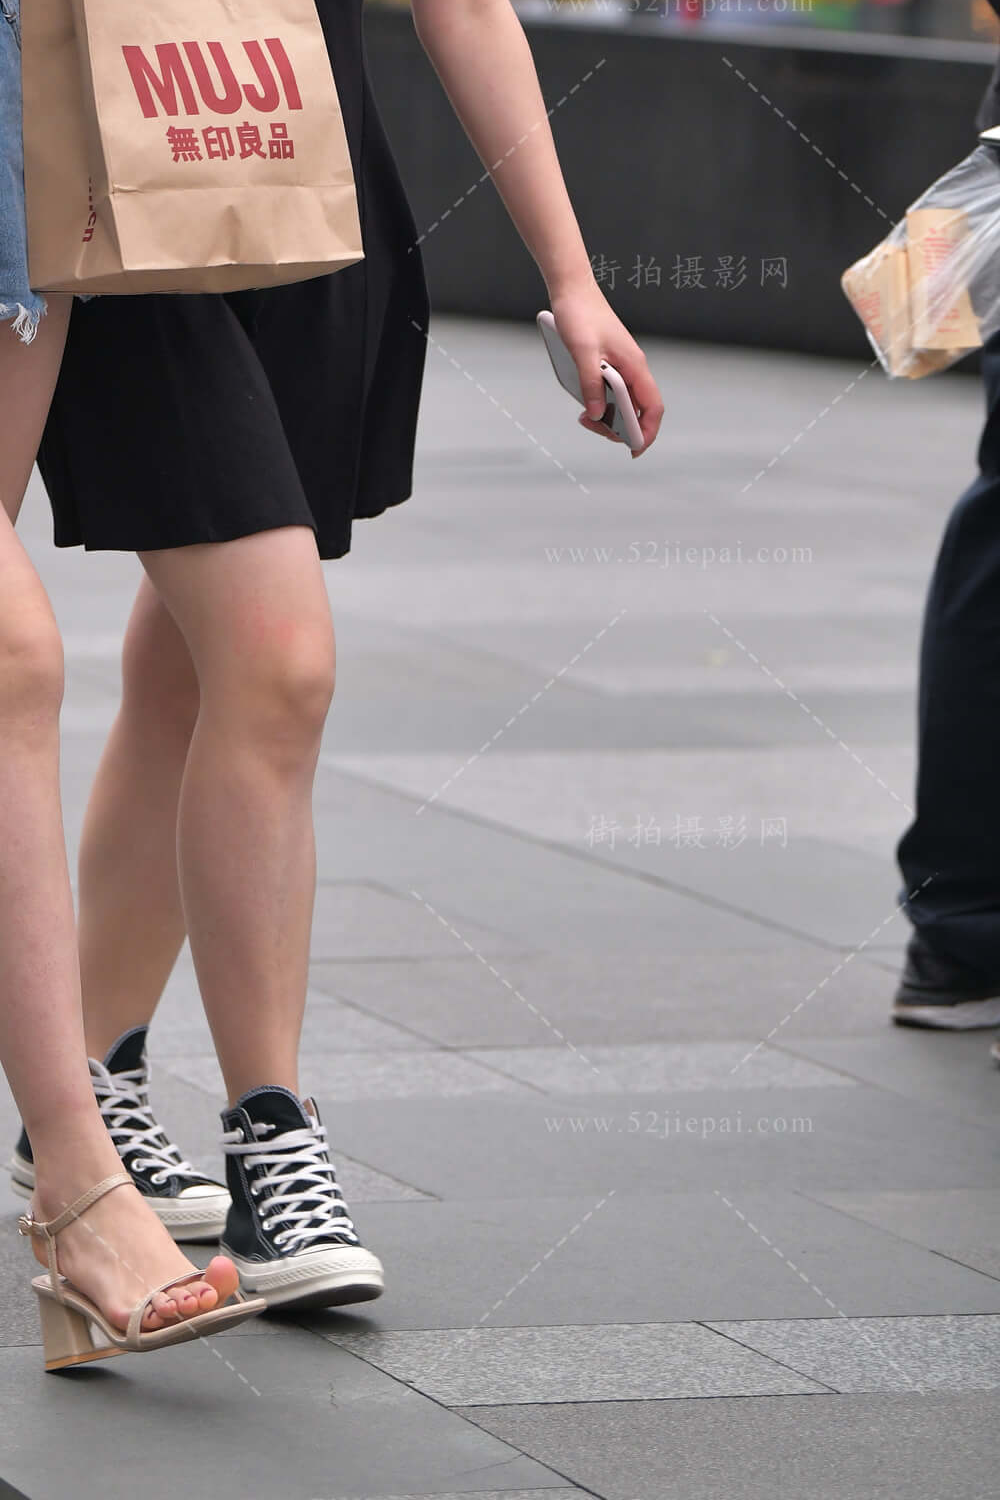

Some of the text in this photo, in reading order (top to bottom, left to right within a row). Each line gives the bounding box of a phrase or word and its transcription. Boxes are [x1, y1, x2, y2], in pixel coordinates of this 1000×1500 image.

[122, 38, 302, 118] MUJI
[166, 122, 294, 161] 無印良品
